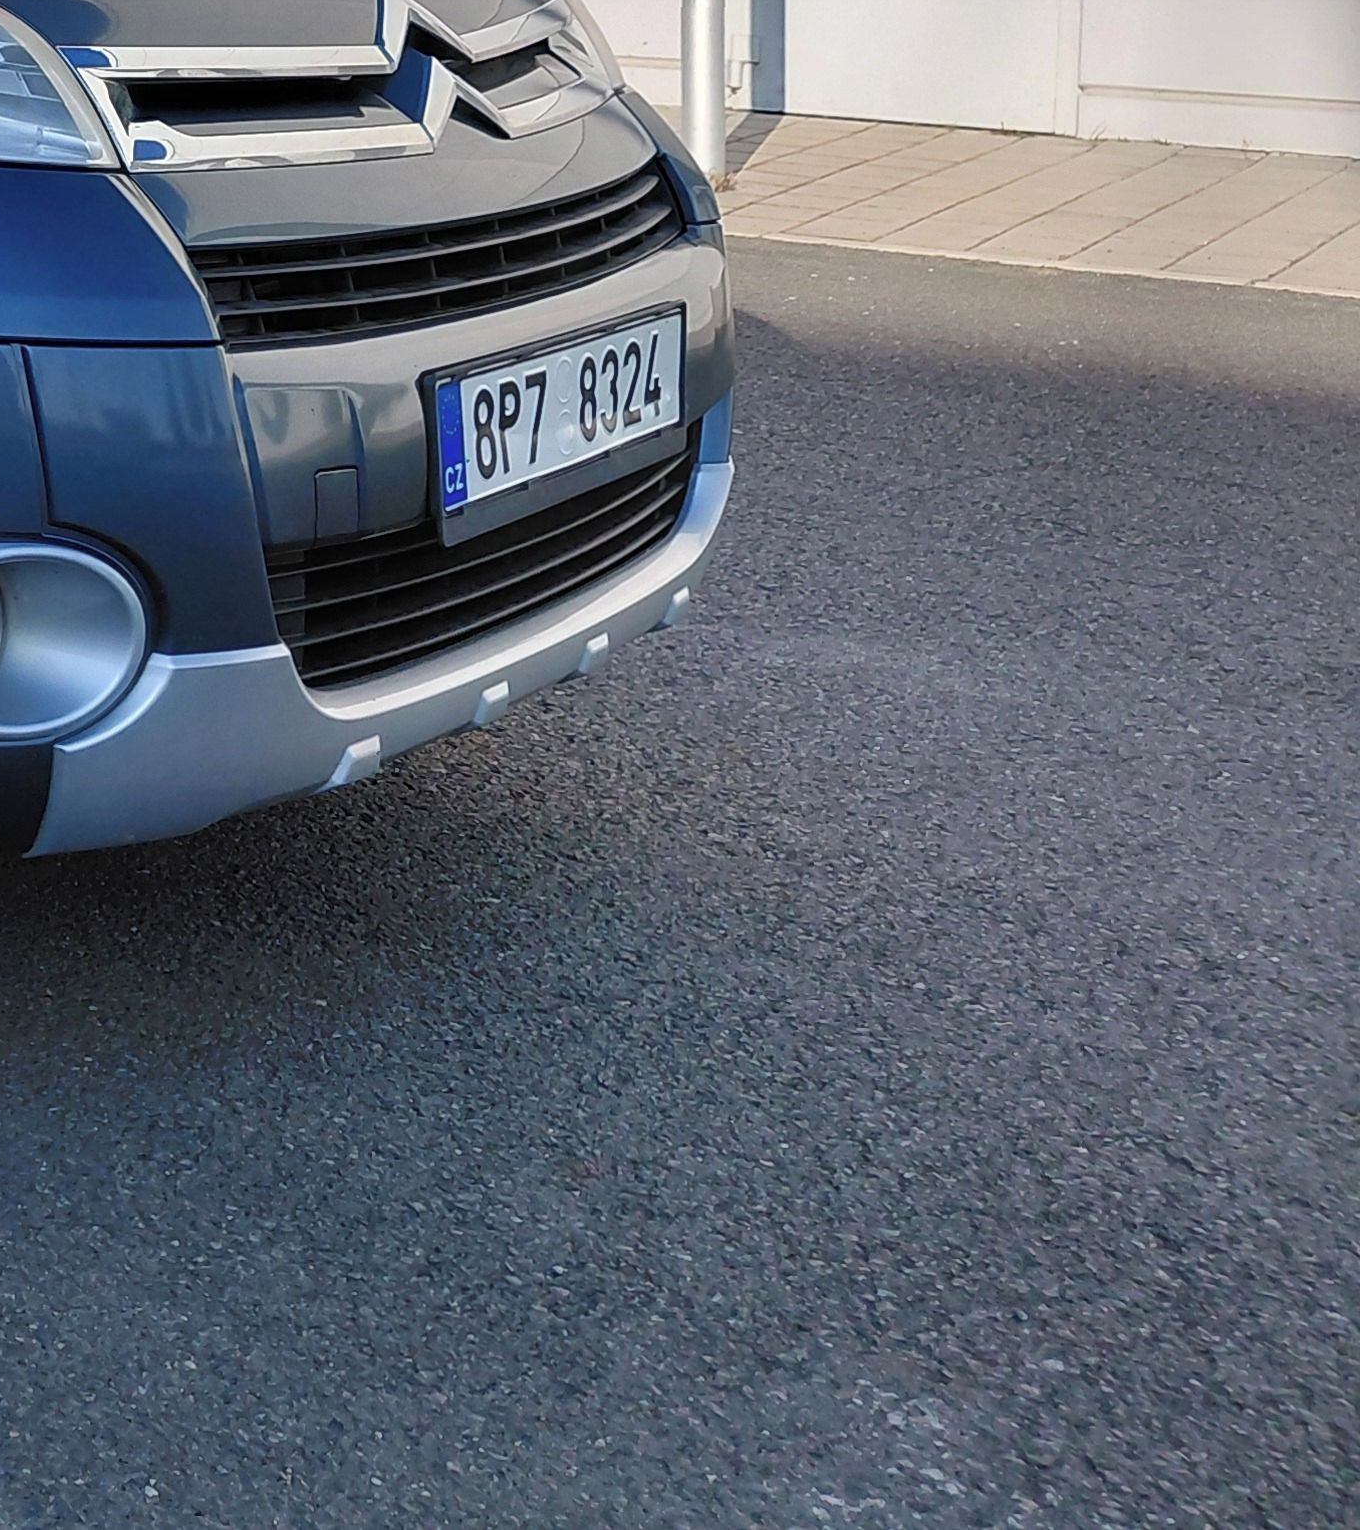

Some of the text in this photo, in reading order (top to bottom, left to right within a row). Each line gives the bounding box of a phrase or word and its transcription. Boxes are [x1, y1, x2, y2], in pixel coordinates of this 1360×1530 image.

[473, 331, 662, 480] 8P7 8324
[445, 463, 465, 495] CZ
